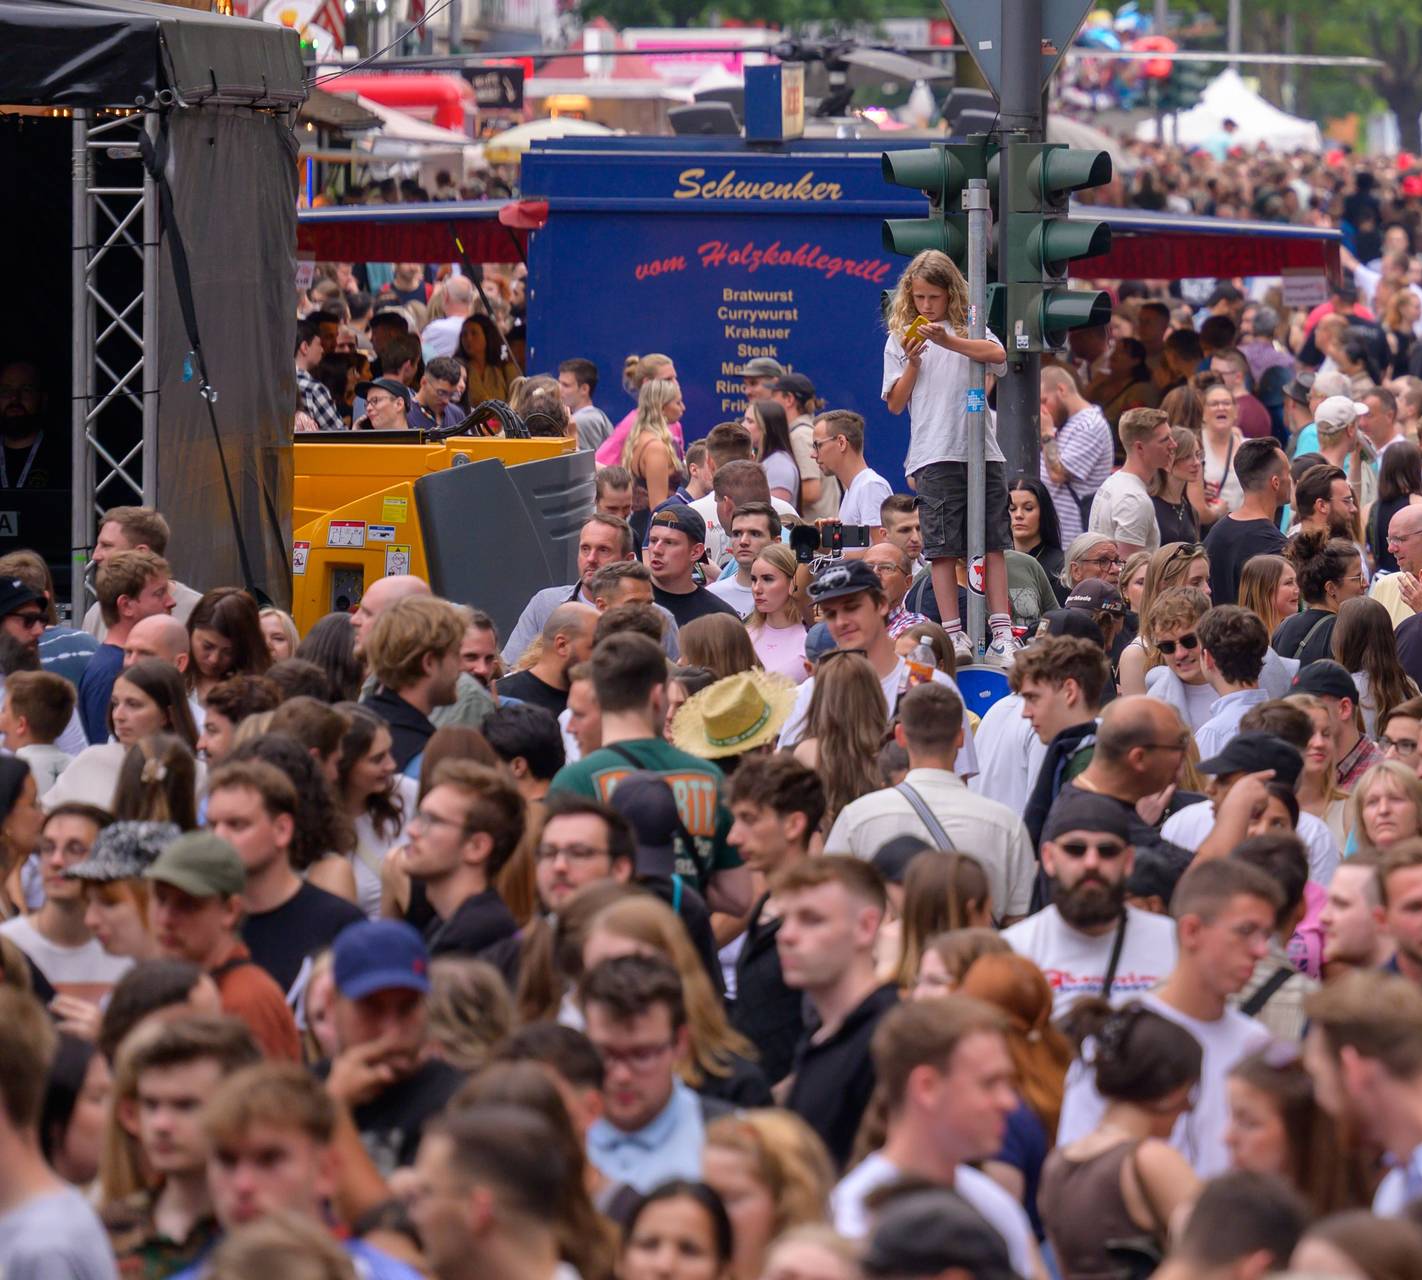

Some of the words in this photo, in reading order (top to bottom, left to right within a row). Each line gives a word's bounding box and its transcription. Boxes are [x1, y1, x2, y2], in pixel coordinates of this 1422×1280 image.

[673, 168, 843, 200] Schwenker
[635, 255, 687, 281] vom
[697, 240, 892, 283] Holzkohlegrill
[723, 288, 793, 302] Bratwurst
[717, 306, 798, 322] Currywurst
[725, 325, 790, 338] Krakauer
[738, 344, 777, 357] Steak
